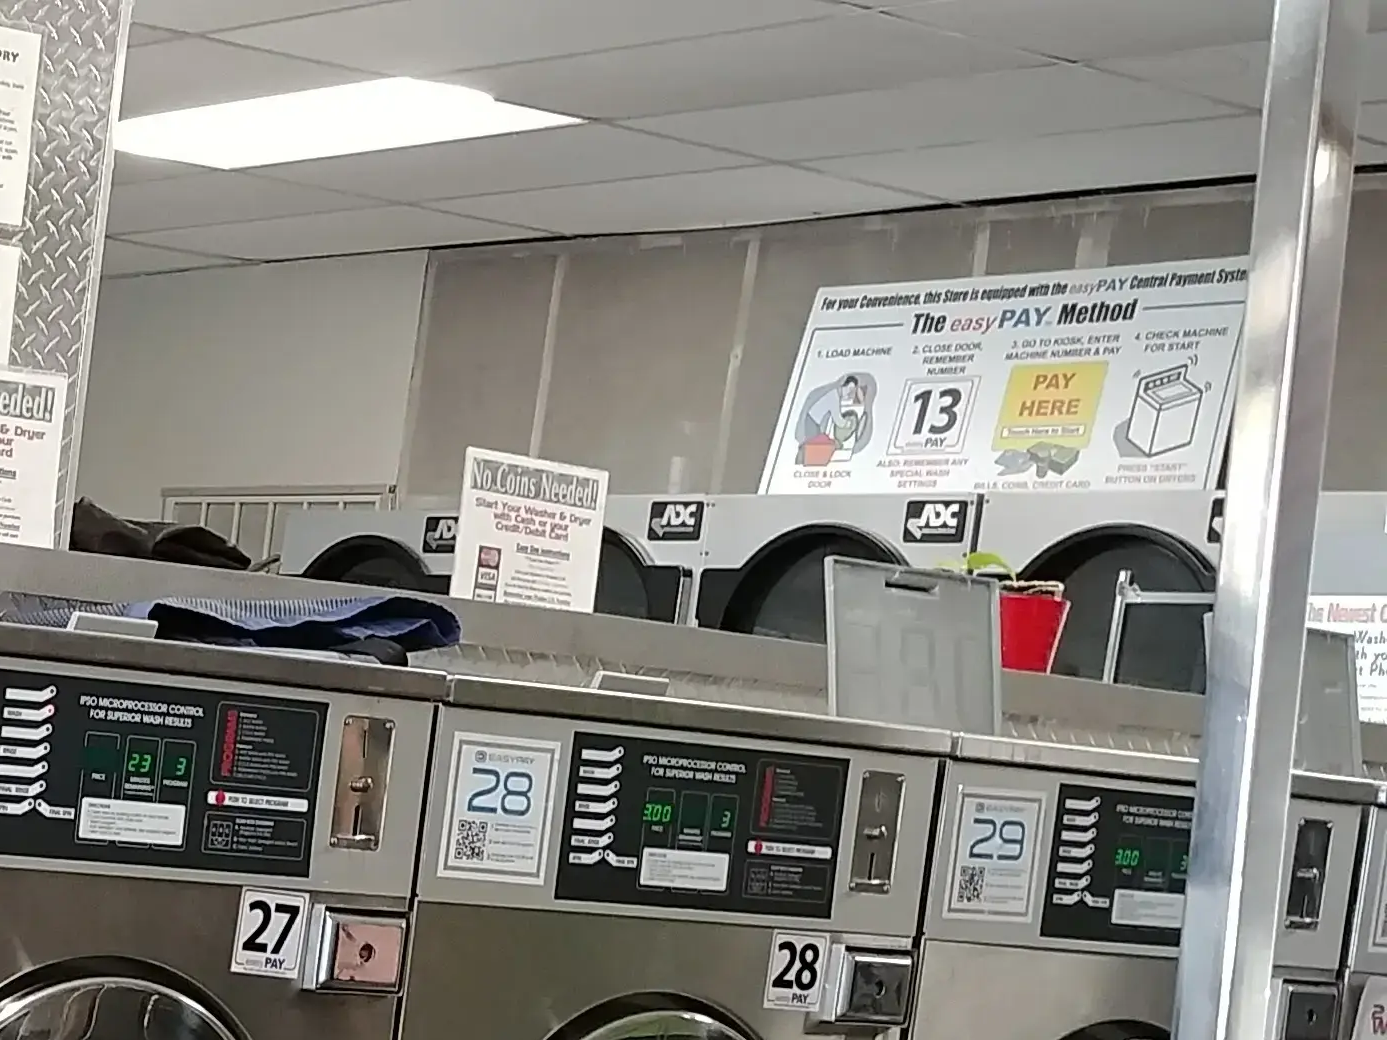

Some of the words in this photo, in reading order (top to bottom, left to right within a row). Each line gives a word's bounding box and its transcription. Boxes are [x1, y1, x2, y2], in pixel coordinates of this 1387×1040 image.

[821, 298, 836, 310] For
[837, 298, 859, 311] your
[923, 290, 942, 303] this
[944, 289, 969, 302] Store
[970, 289, 979, 301] is
[980, 285, 1027, 301] equipped
[1028, 284, 1049, 297] with
[1051, 282, 1068, 295] the
[1129, 274, 1168, 290] Central
[1169, 272, 1215, 287] Payment
[1216, 268, 1247, 283] Syste
[912, 312, 946, 334] The
[1057, 298, 1139, 325] Method
[1087, 334, 1120, 344] ENTER
[1145, 331, 1179, 341] CHECK
[1183, 327, 1229, 337] MACHINE
[826, 349, 851, 358] LOAD
[855, 347, 893, 356] MACHINE
[922, 344, 952, 353] CLOSE
[1102, 346, 1122, 355] PAY
[1144, 343, 1165, 352] FOR
[1167, 341, 1200, 351] START
[922, 354, 974, 364] REMEMBER
[927, 367, 965, 375] NUMBER
[1033, 373, 1076, 391] PAY
[912, 388, 962, 435] 13
[1018, 399, 1080, 417] HERE
[0, 424, 9, 434] &
[15, 425, 45, 441] Dryer
[924, 437, 947, 448] PAY
[472, 460, 491, 490] No
[497, 465, 535, 496] Coins
[540, 472, 598, 508] Needed!
[476, 497, 498, 509] Start
[501, 501, 521, 513] Your
[569, 513, 592, 526] Dryer
[661, 504, 697, 526] ADC
[919, 504, 960, 527] ADC
[1327, 603, 1376, 622] Newest
[127, 753, 152, 773] 23
[176, 758, 187, 775] 3
[467, 768, 533, 817] 28
[968, 817, 1025, 860] 29
[243, 900, 300, 954] 27
[264, 956, 285, 970] PAY
[772, 941, 820, 990] 28
[791, 992, 809, 1004] PAY
